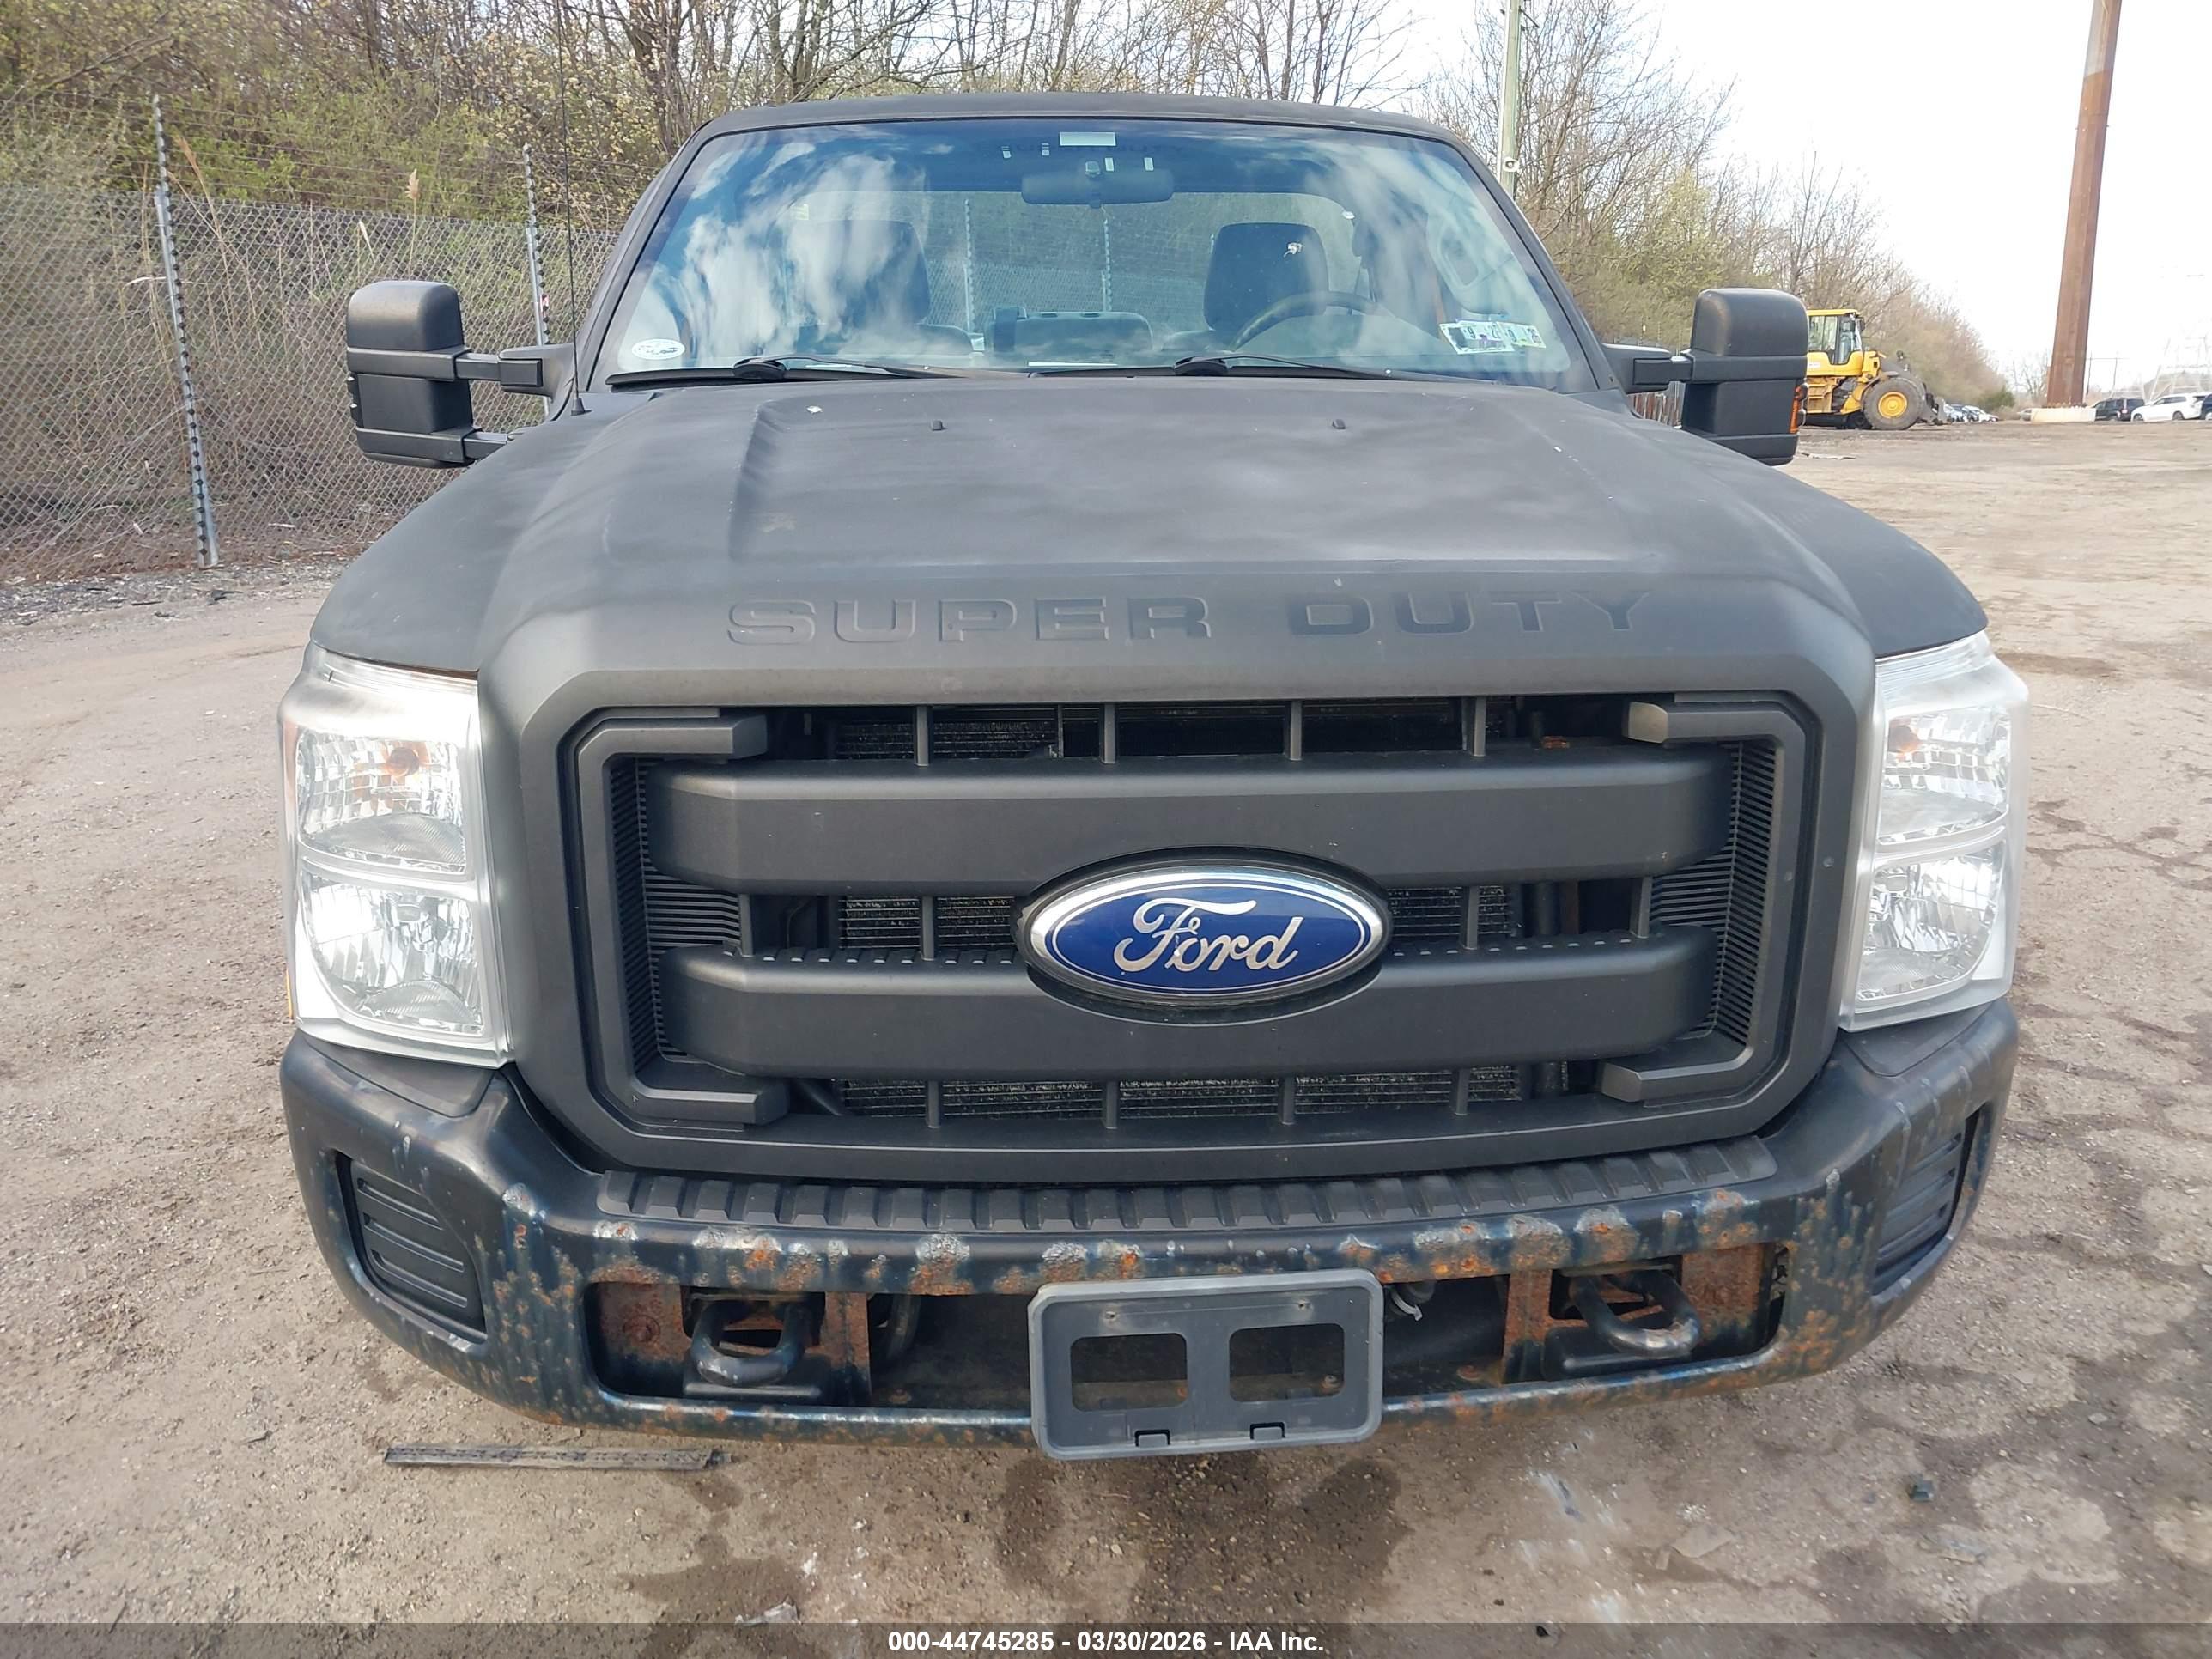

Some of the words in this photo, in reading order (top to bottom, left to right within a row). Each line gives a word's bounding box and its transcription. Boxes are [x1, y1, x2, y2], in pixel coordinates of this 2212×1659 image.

[726, 596, 1212, 645] SUPER
[1288, 590, 1652, 636] DUTY
[1113, 896, 1304, 972] Ford
